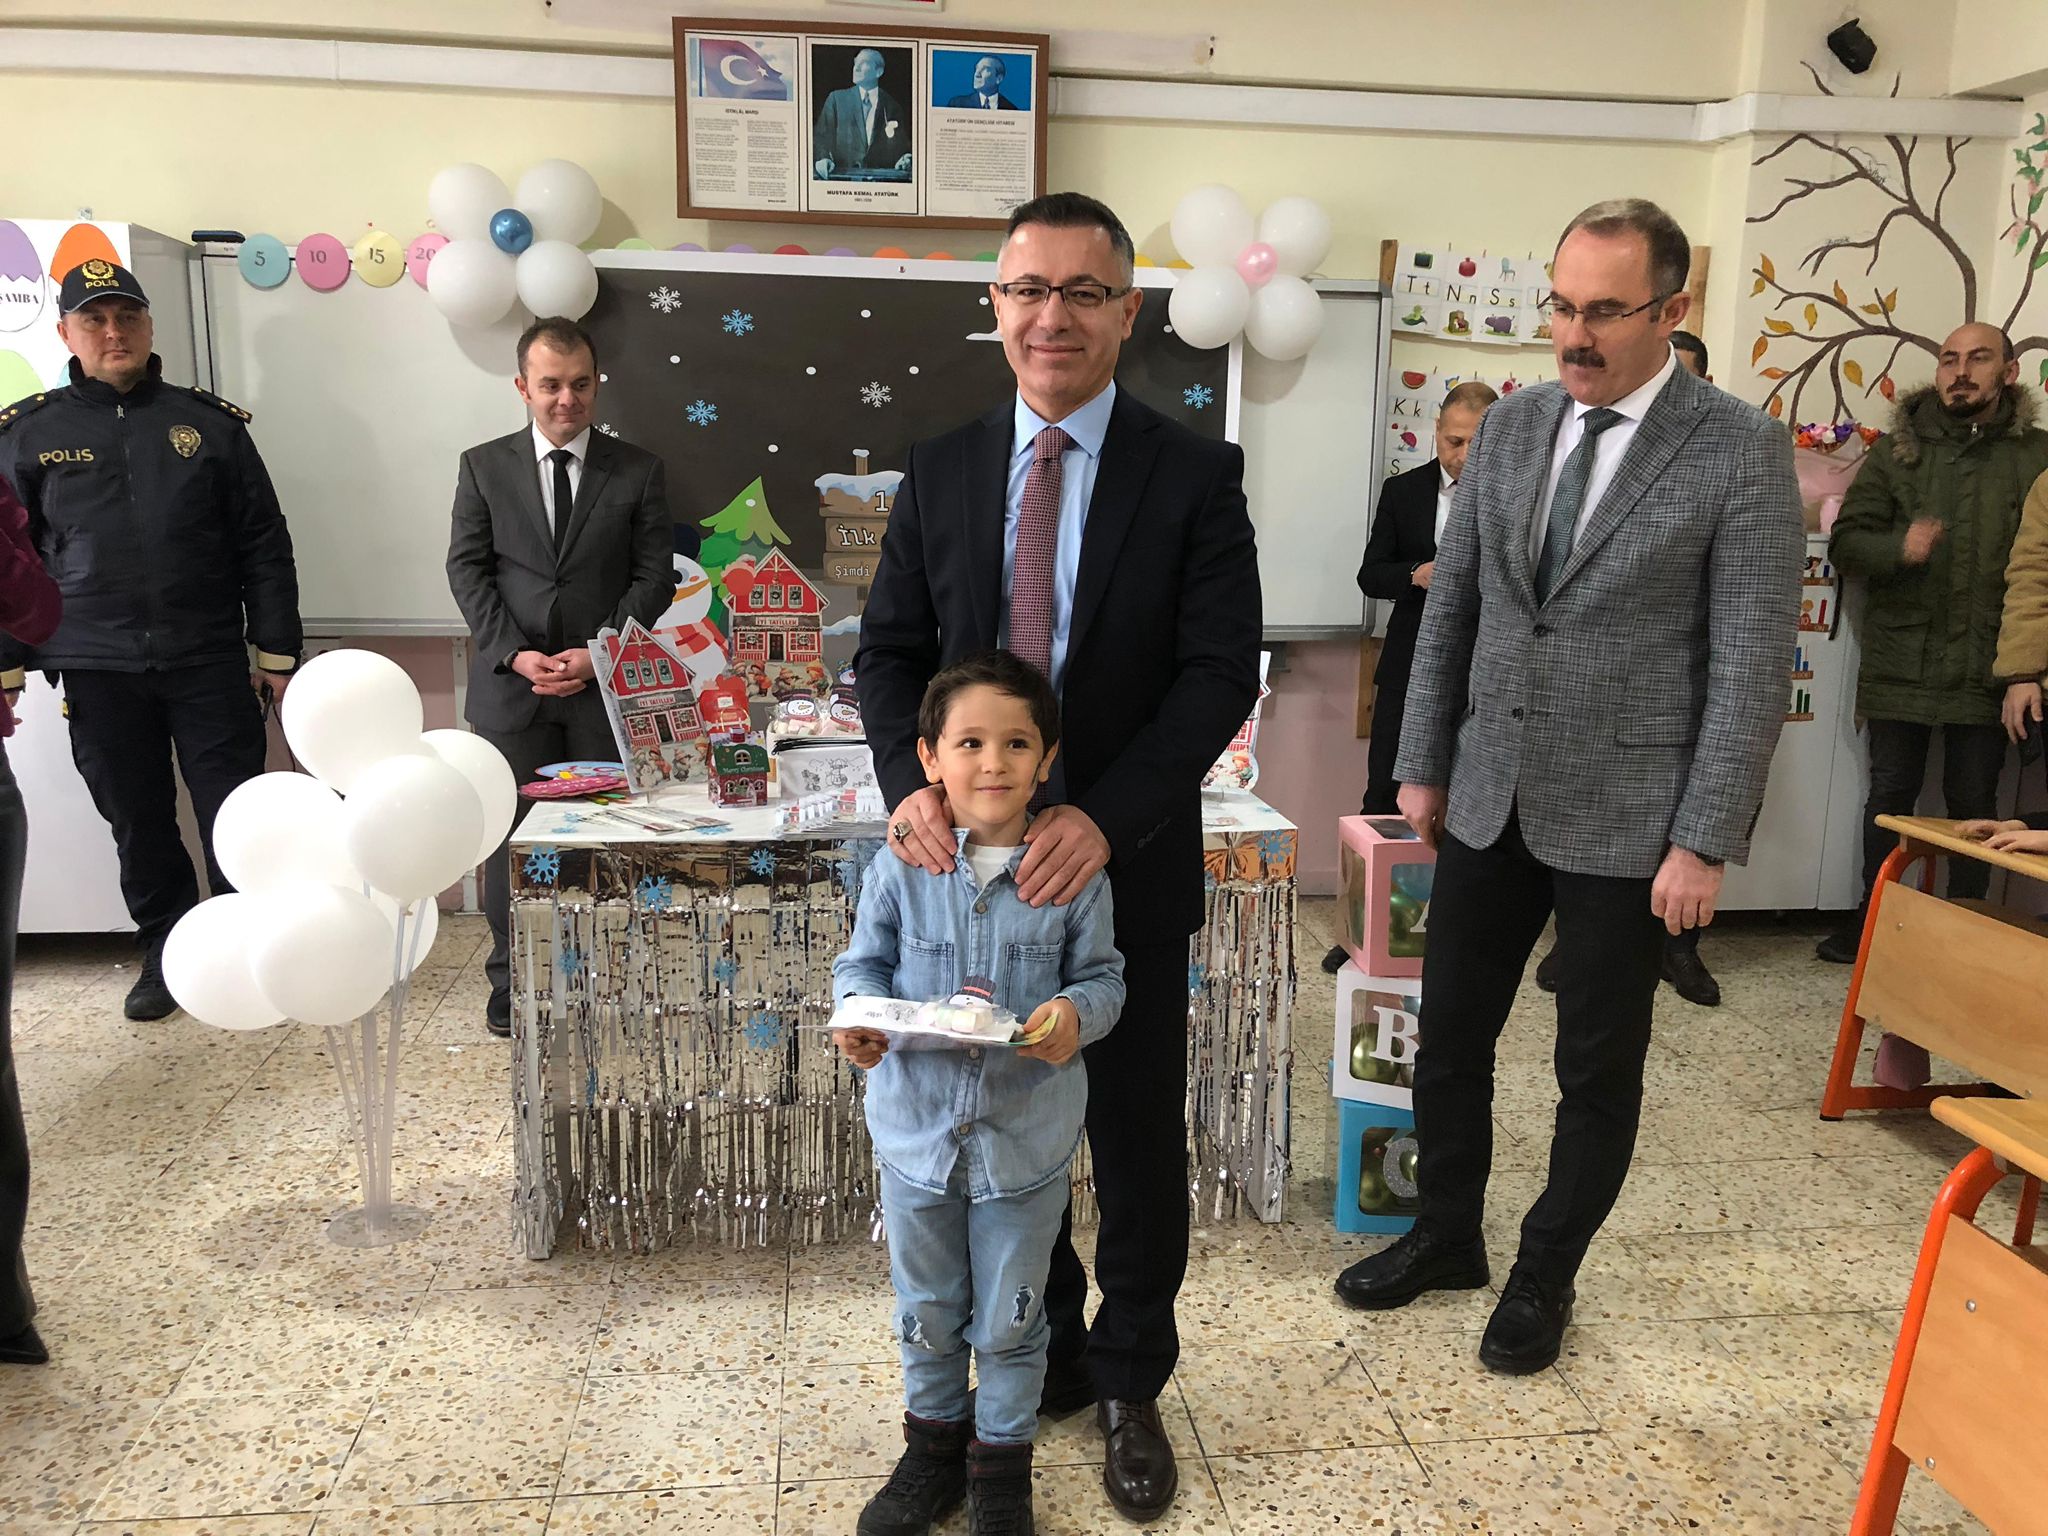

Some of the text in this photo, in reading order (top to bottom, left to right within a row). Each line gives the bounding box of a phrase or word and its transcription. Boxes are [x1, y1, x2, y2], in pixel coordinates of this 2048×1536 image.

[254, 251, 266, 267] 5
[309, 249, 327, 264] 10
[369, 247, 385, 265] 15
[415, 247, 436, 261] 20
[85, 280, 120, 289] POLİS
[1407, 275, 1430, 295] T t
[1446, 284, 1477, 304] N n
[1489, 288, 1516, 308] S s
[1393, 397, 1421, 417] K k
[38, 448, 95, 466] POLİS
[875, 490, 889, 512] 1
[837, 524, 877, 546] İlk
[835, 565, 871, 579] Şimdi
[723, 766, 740, 774] Merry
[1369, 1005, 1420, 1064] B
